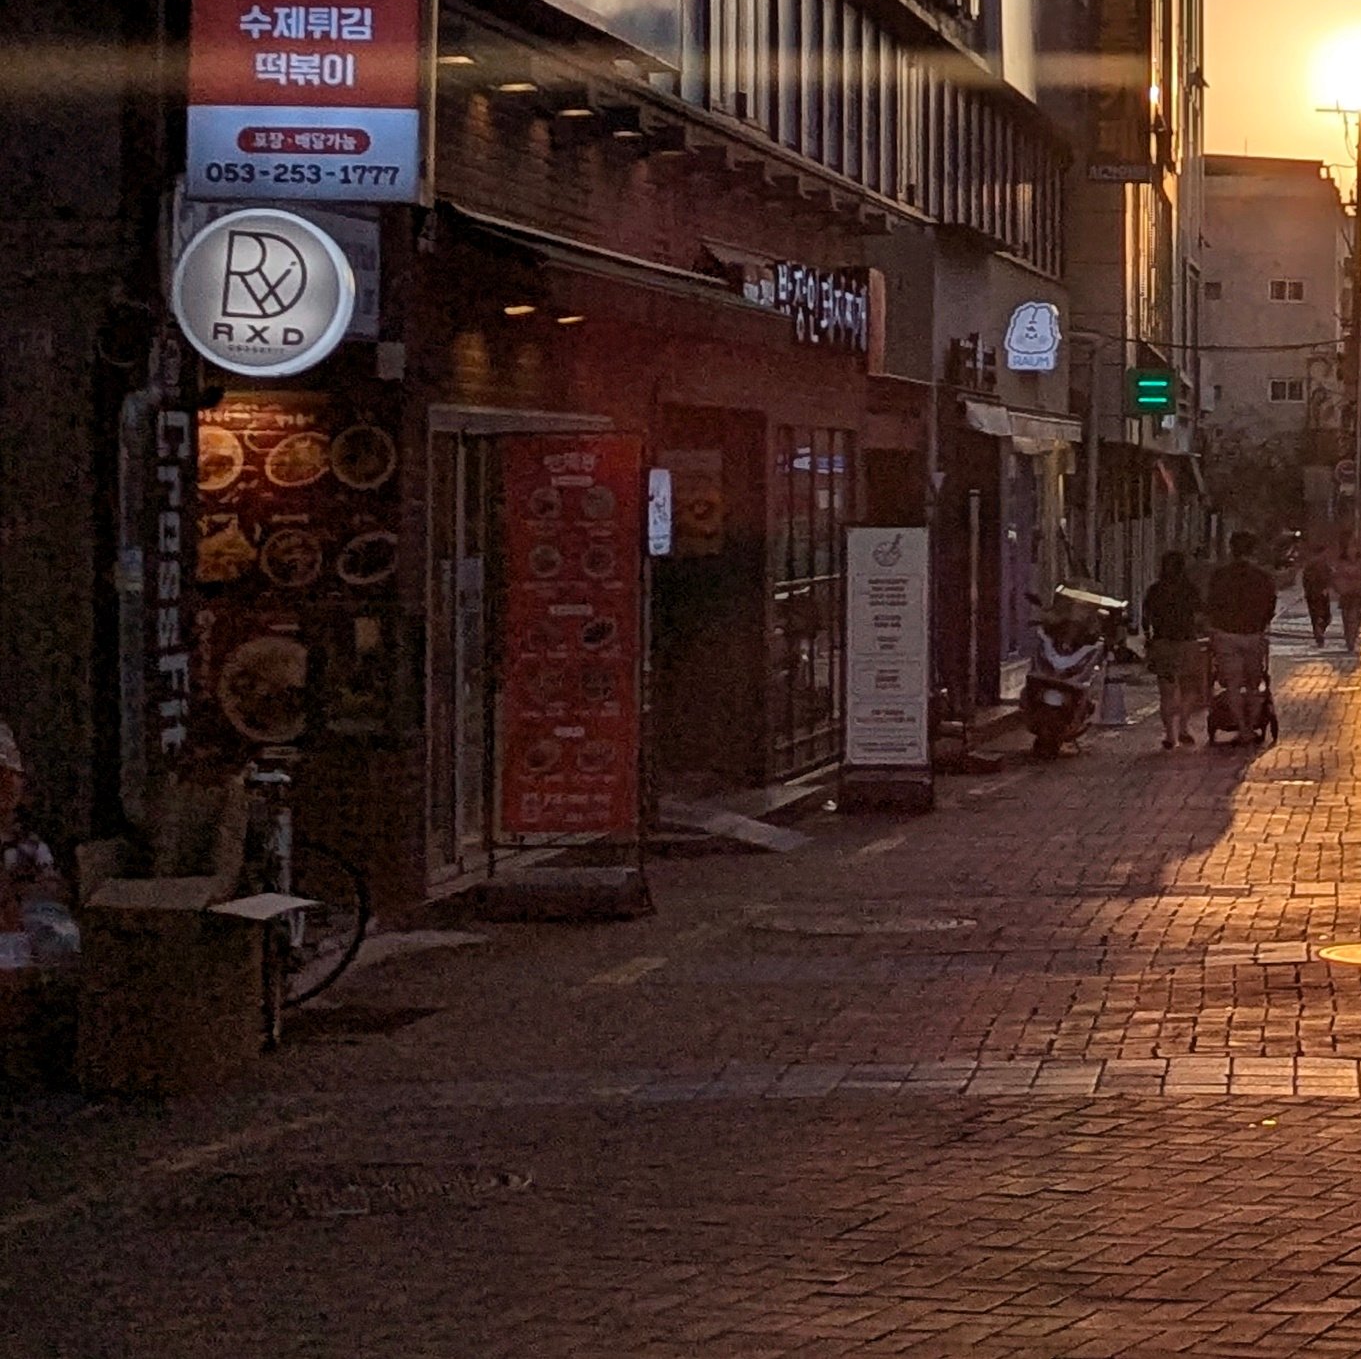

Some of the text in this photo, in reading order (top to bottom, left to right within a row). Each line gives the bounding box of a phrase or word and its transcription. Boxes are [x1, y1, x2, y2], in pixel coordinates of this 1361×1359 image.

[239, 4, 374, 40] 수제튀김
[255, 52, 355, 86] 떡볶이
[205, 162, 400, 186] 053-253-1777
[212, 321, 304, 346] RXD
[1011, 355, 1050, 367] RAUM
[154, 410, 190, 754] CrossFit
